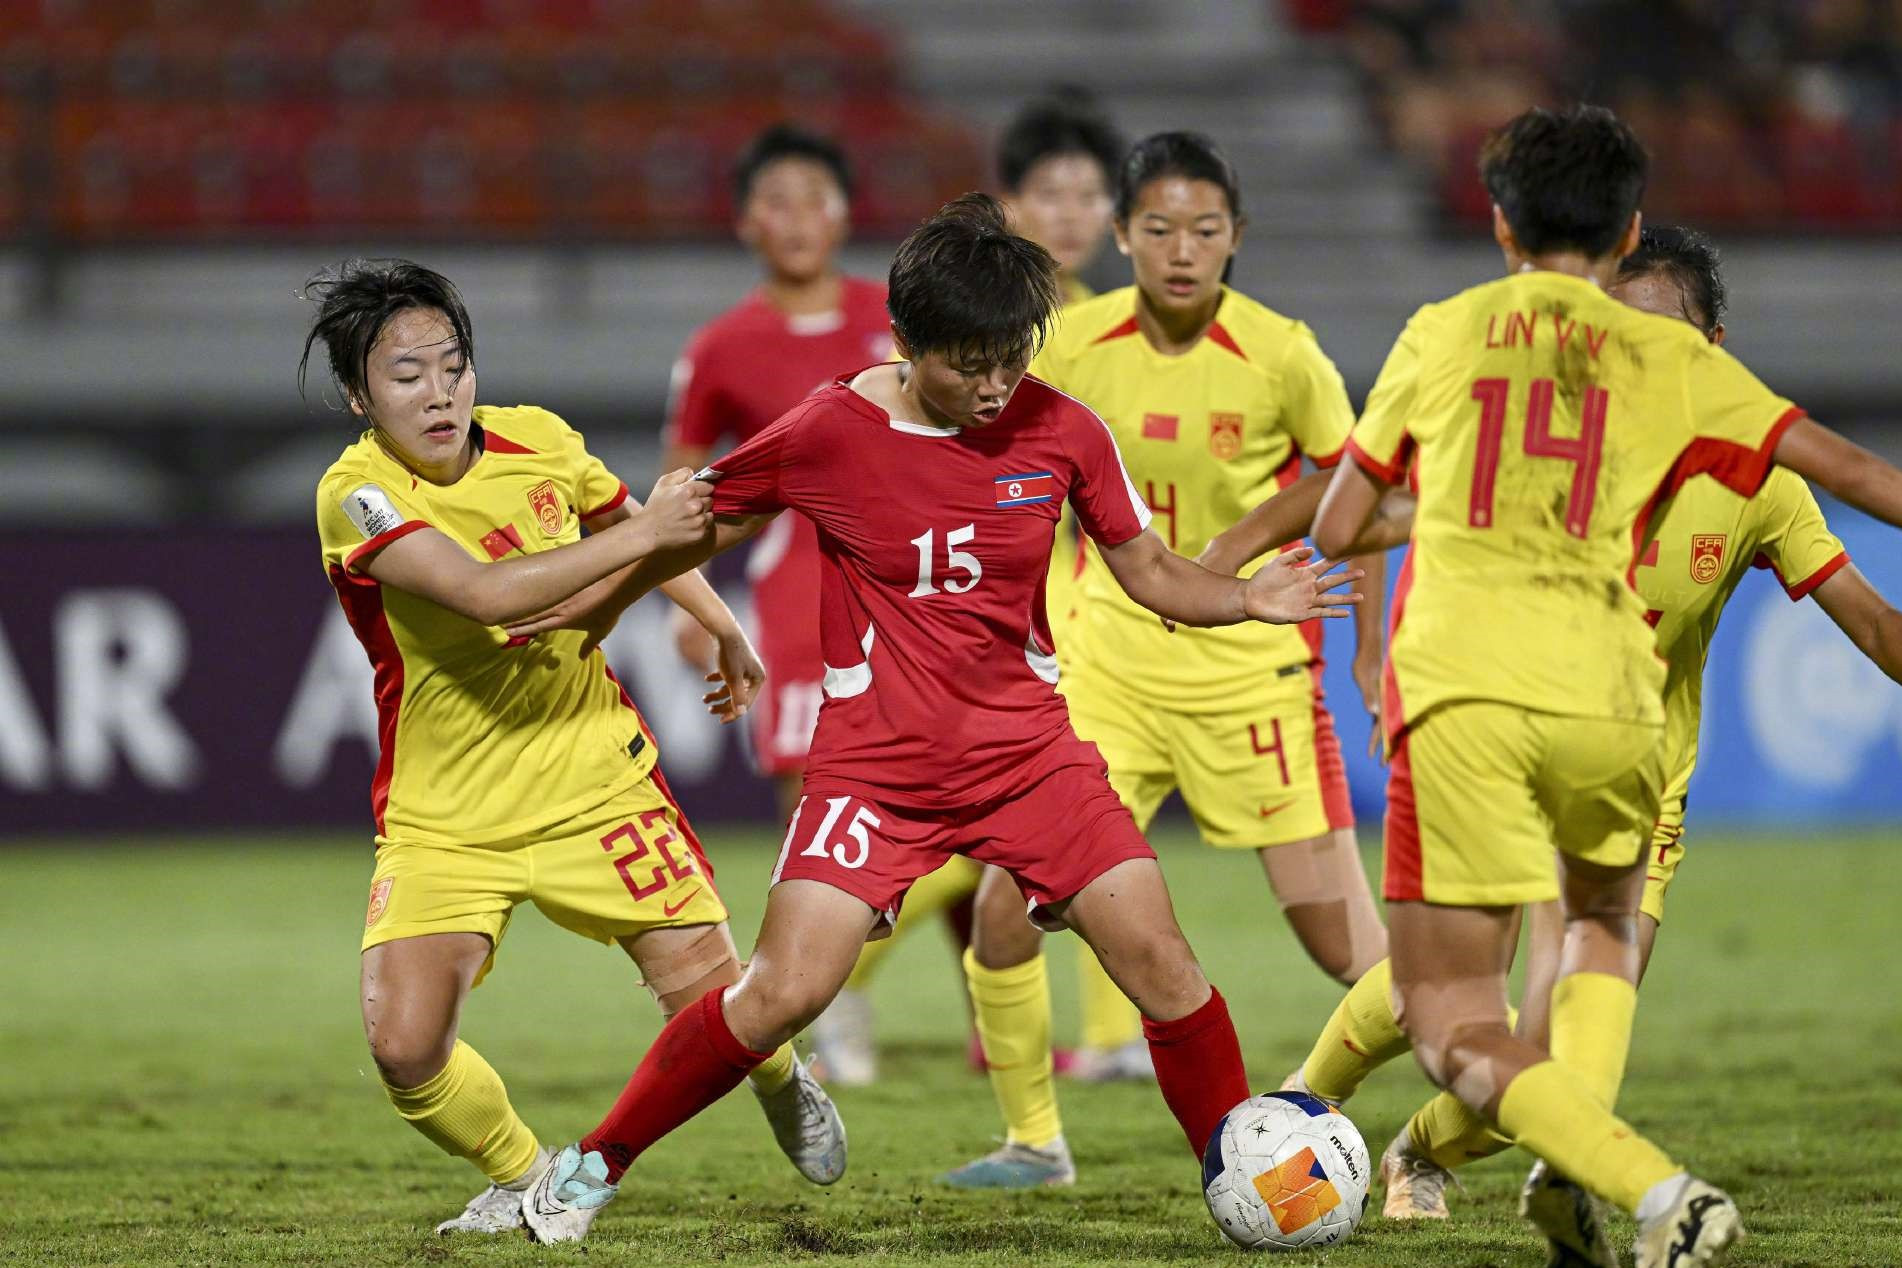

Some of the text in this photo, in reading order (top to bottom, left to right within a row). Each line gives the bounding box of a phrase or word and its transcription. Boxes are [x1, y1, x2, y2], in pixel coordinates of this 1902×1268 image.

[1486, 309, 1537, 350] LIN
[1468, 378, 1609, 540] 14
[1146, 479, 1177, 549] 4
[1696, 538, 1722, 548] CFA
[907, 523, 982, 599] 15
[1248, 717, 1290, 786] 4
[600, 807, 695, 902] 22
[800, 795, 880, 870] 15
[1329, 1134, 1360, 1181] molten
